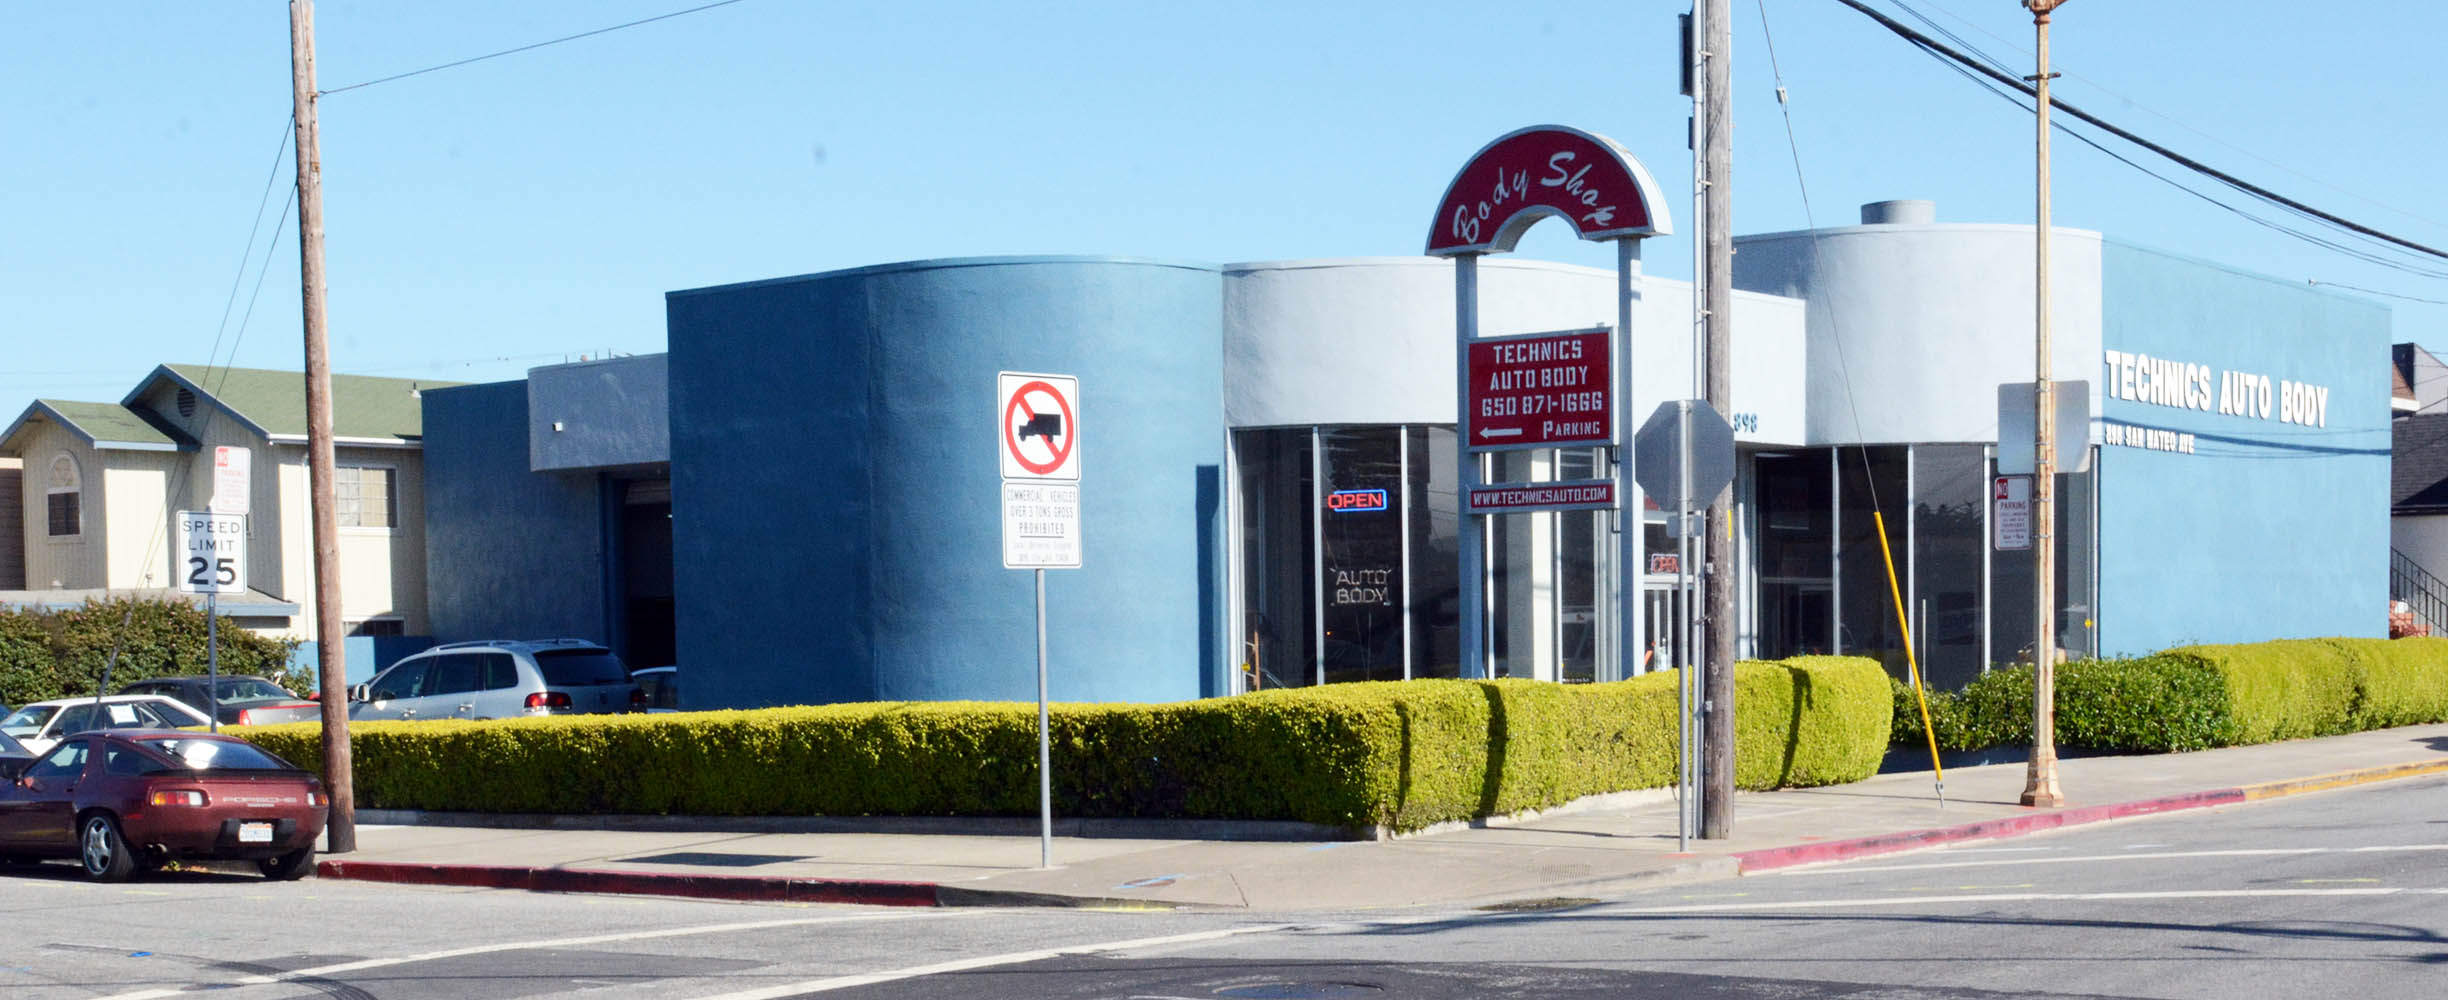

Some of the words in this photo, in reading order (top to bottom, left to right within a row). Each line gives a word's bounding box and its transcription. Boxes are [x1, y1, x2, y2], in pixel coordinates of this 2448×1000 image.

[1452, 167, 1529, 244] Body
[1540, 151, 1617, 226] Shop
[1493, 339, 1582, 364] TECHNICS
[1490, 369, 1536, 391] AUTO
[1541, 365, 1588, 388] BODY
[2105, 350, 2212, 412] TECHNICS
[2218, 370, 2272, 420] AUTO
[2280, 379, 2329, 429] BODY
[1482, 396, 1517, 417] 650
[1522, 391, 1603, 415] 871-1666
[1734, 413, 1758, 433] 898
[2105, 424, 2123, 445] 898
[2125, 425, 2144, 448] SAN
[2146, 429, 2176, 452] MATEO
[2178, 433, 2195, 454] AVE
[1007, 488, 1043, 502] COMMERCIAL
[1050, 490, 1076, 503] VEHICLES
[1473, 487, 1607, 505] WWW.TECHNICSAUTO.COM
[1997, 482, 2008, 496] NO
[1327, 492, 1382, 509] OPEN
[1010, 505, 1026, 518] OVER
[1035, 505, 1051, 518] TONS
[1054, 506, 1073, 519] GROSS
[183, 520, 240, 533] SPEED
[1019, 522, 1065, 535] PROHIBITED
[188, 539, 235, 551] LIMIT
[187, 556, 236, 586] 25
[1336, 569, 1388, 585] AUTO
[1336, 587, 1388, 604] BODY
